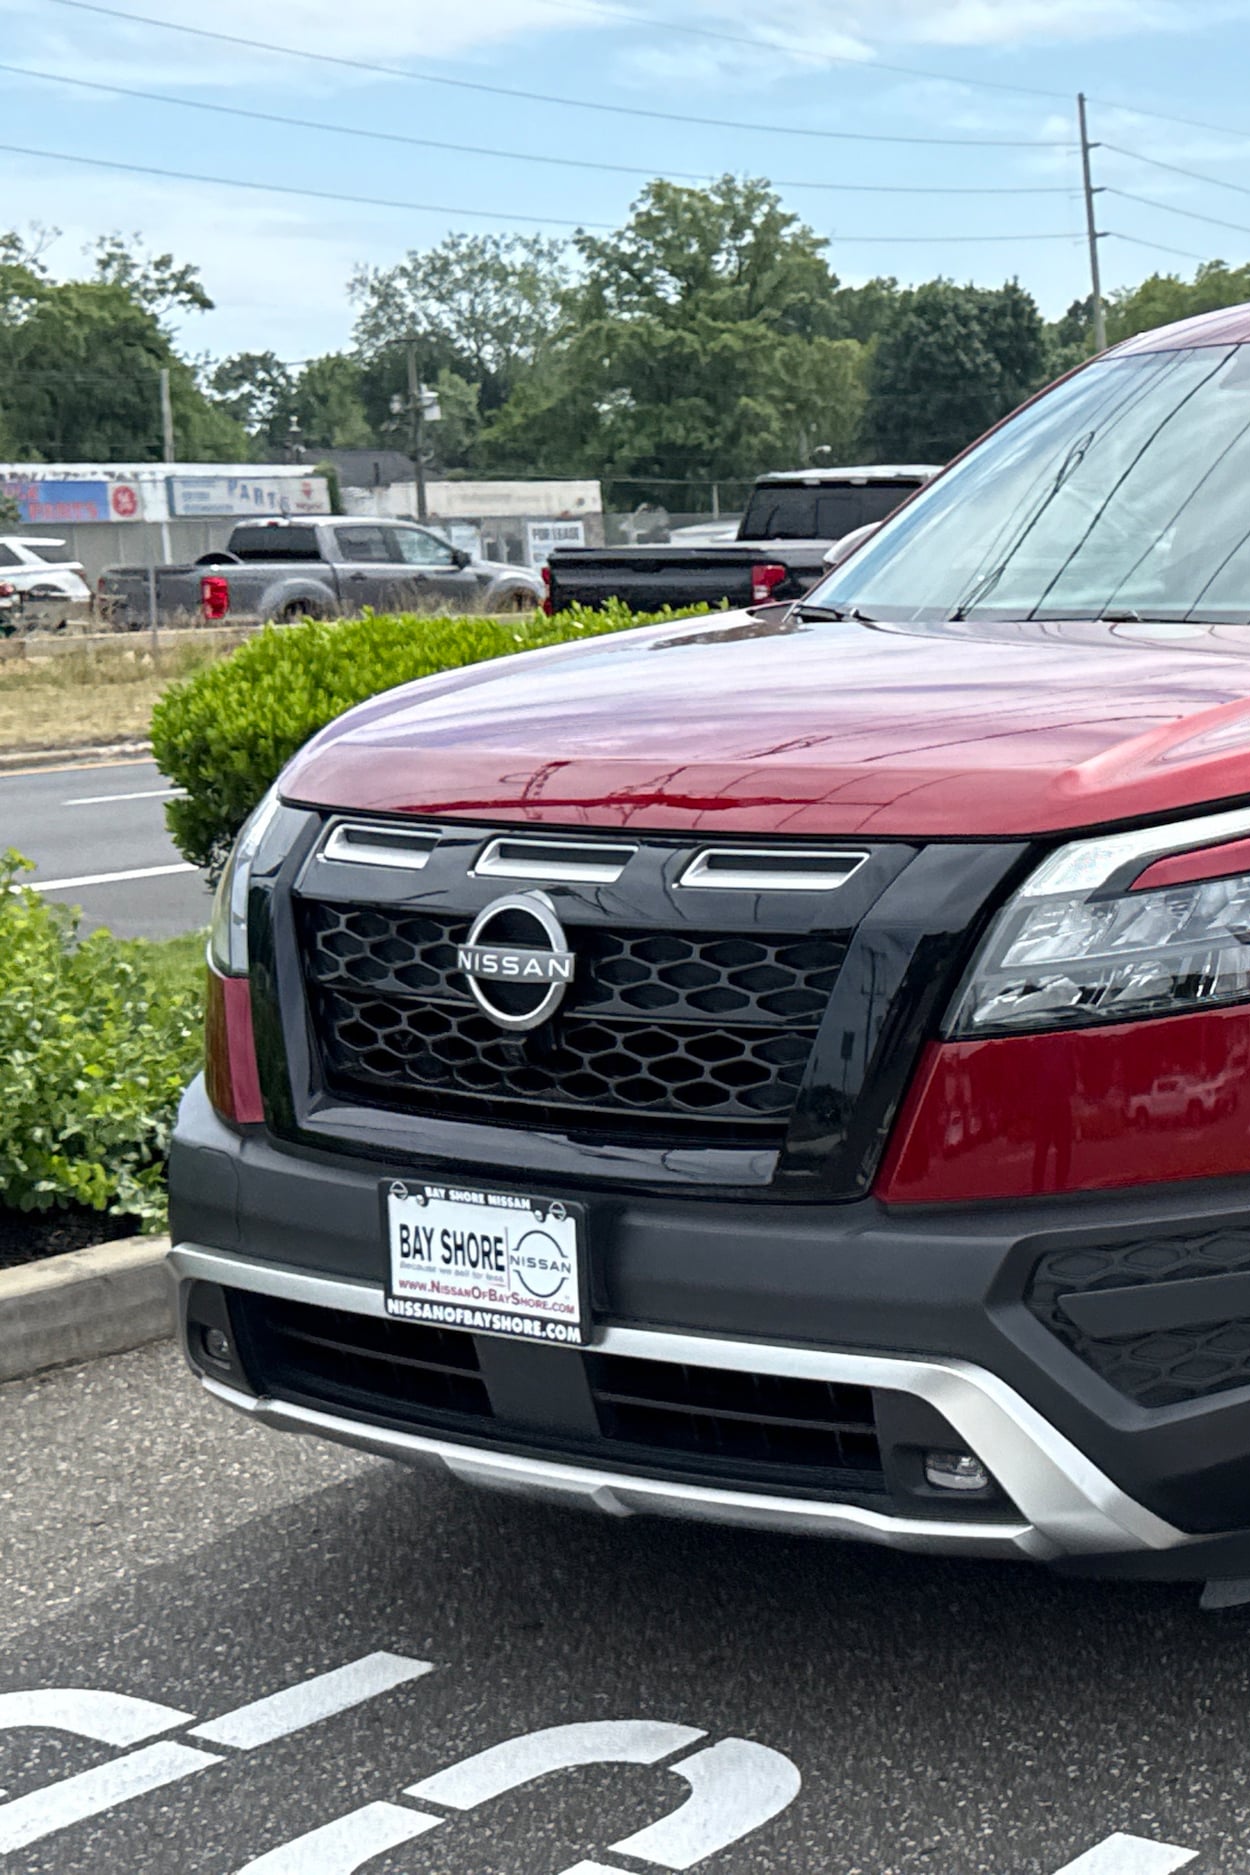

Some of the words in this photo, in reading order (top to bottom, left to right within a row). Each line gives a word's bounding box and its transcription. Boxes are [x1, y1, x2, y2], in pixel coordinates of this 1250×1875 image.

[532, 528, 550, 541] FOR
[552, 526, 579, 540] LEASE
[457, 950, 570, 978] NISSAN
[424, 1186, 446, 1201] BAY
[449, 1190, 485, 1205] SHORE
[488, 1195, 531, 1210] NISSAN
[399, 1223, 434, 1262] BAY
[440, 1228, 505, 1272] SHORE
[510, 1255, 572, 1274] NISSAN
[387, 1298, 582, 1344] NISSANOFBAYSHORE.COM
